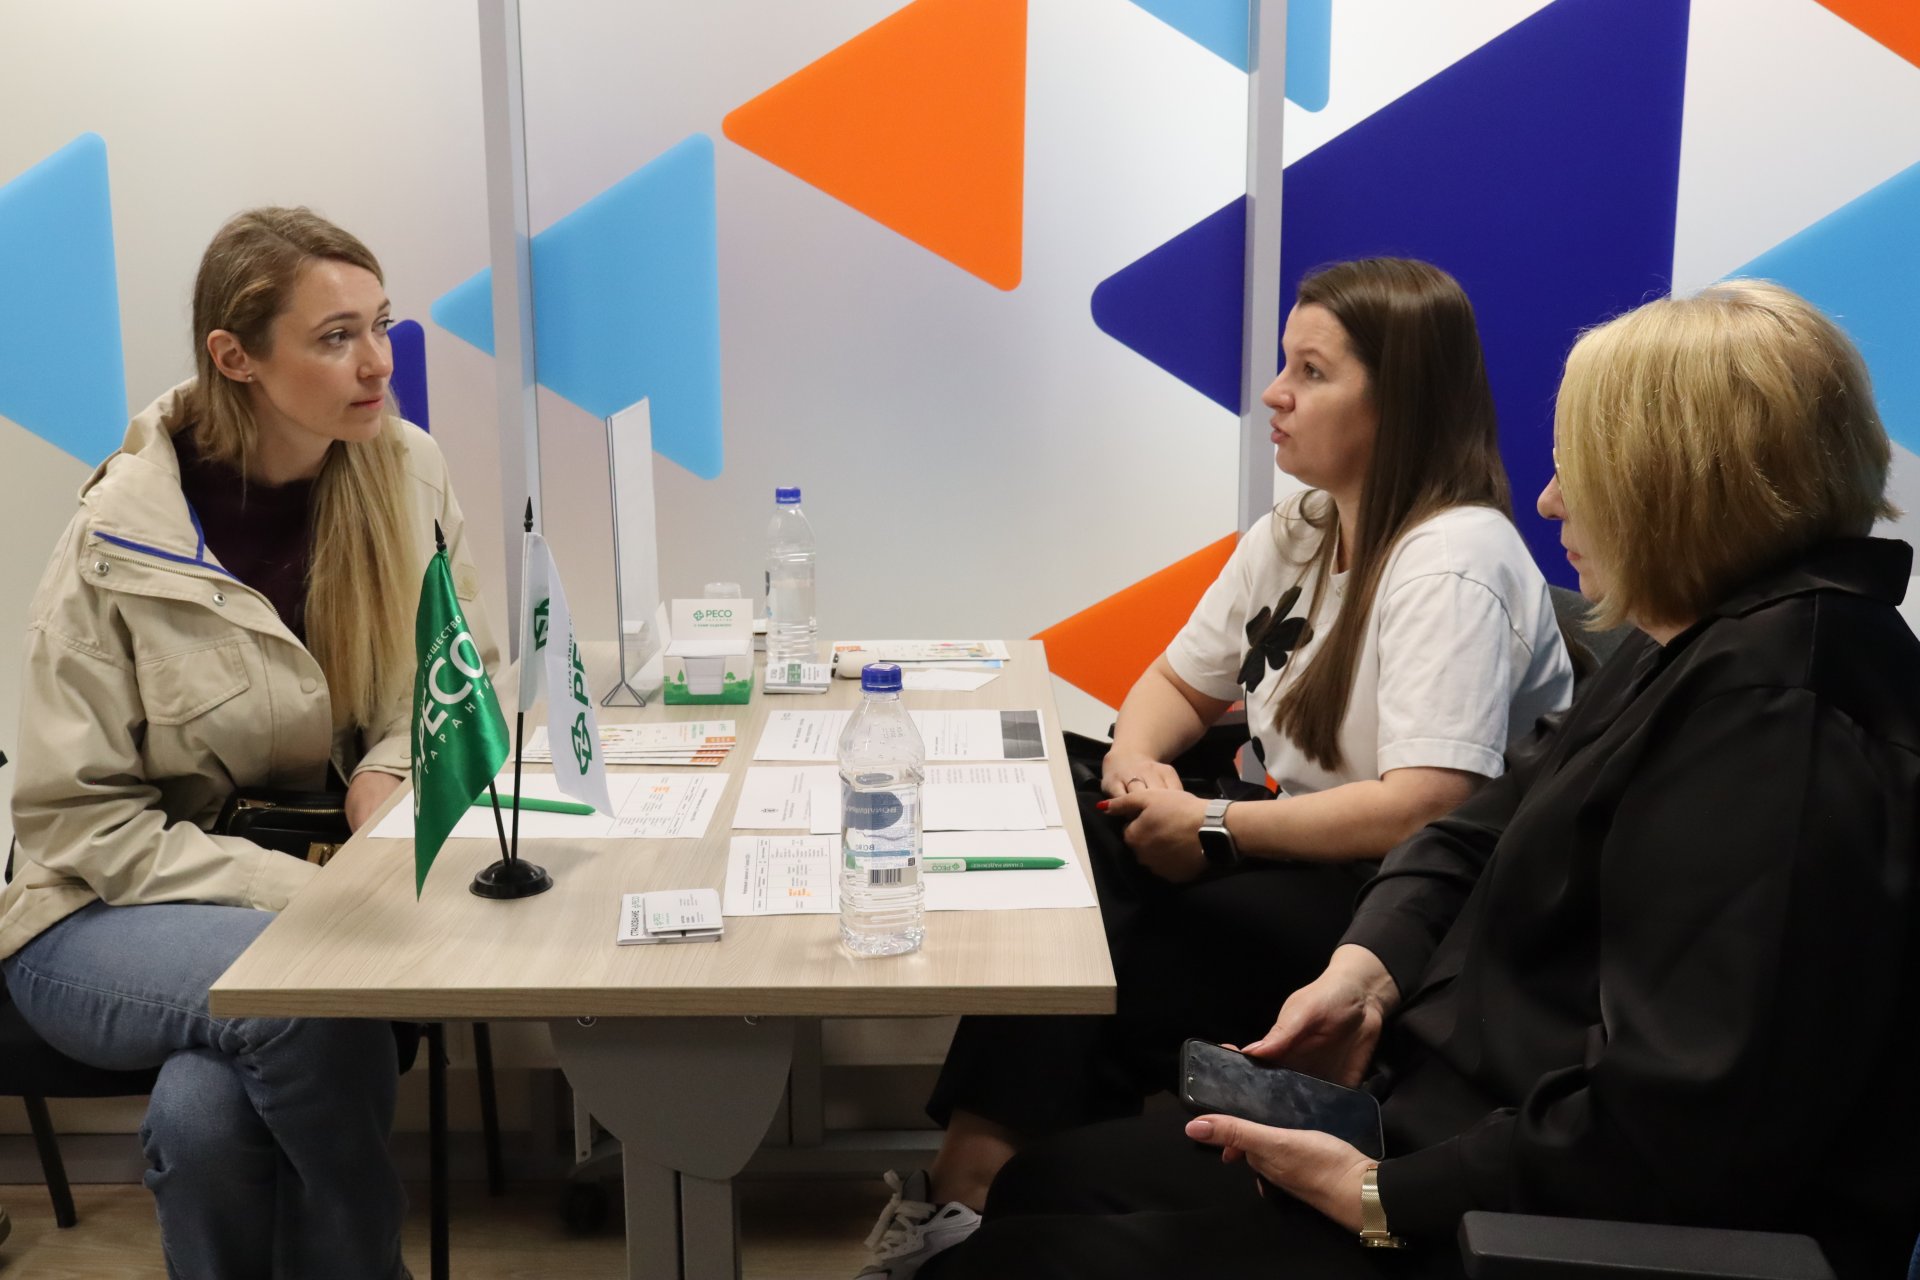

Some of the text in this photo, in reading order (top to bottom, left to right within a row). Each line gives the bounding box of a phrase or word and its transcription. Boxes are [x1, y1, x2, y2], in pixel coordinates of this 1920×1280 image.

[424, 614, 462, 668] ОБЩЕСТВО
[706, 609, 733, 618] РЕСО
[418, 631, 485, 765] РЕСО
[572, 642, 589, 707] РЕ
